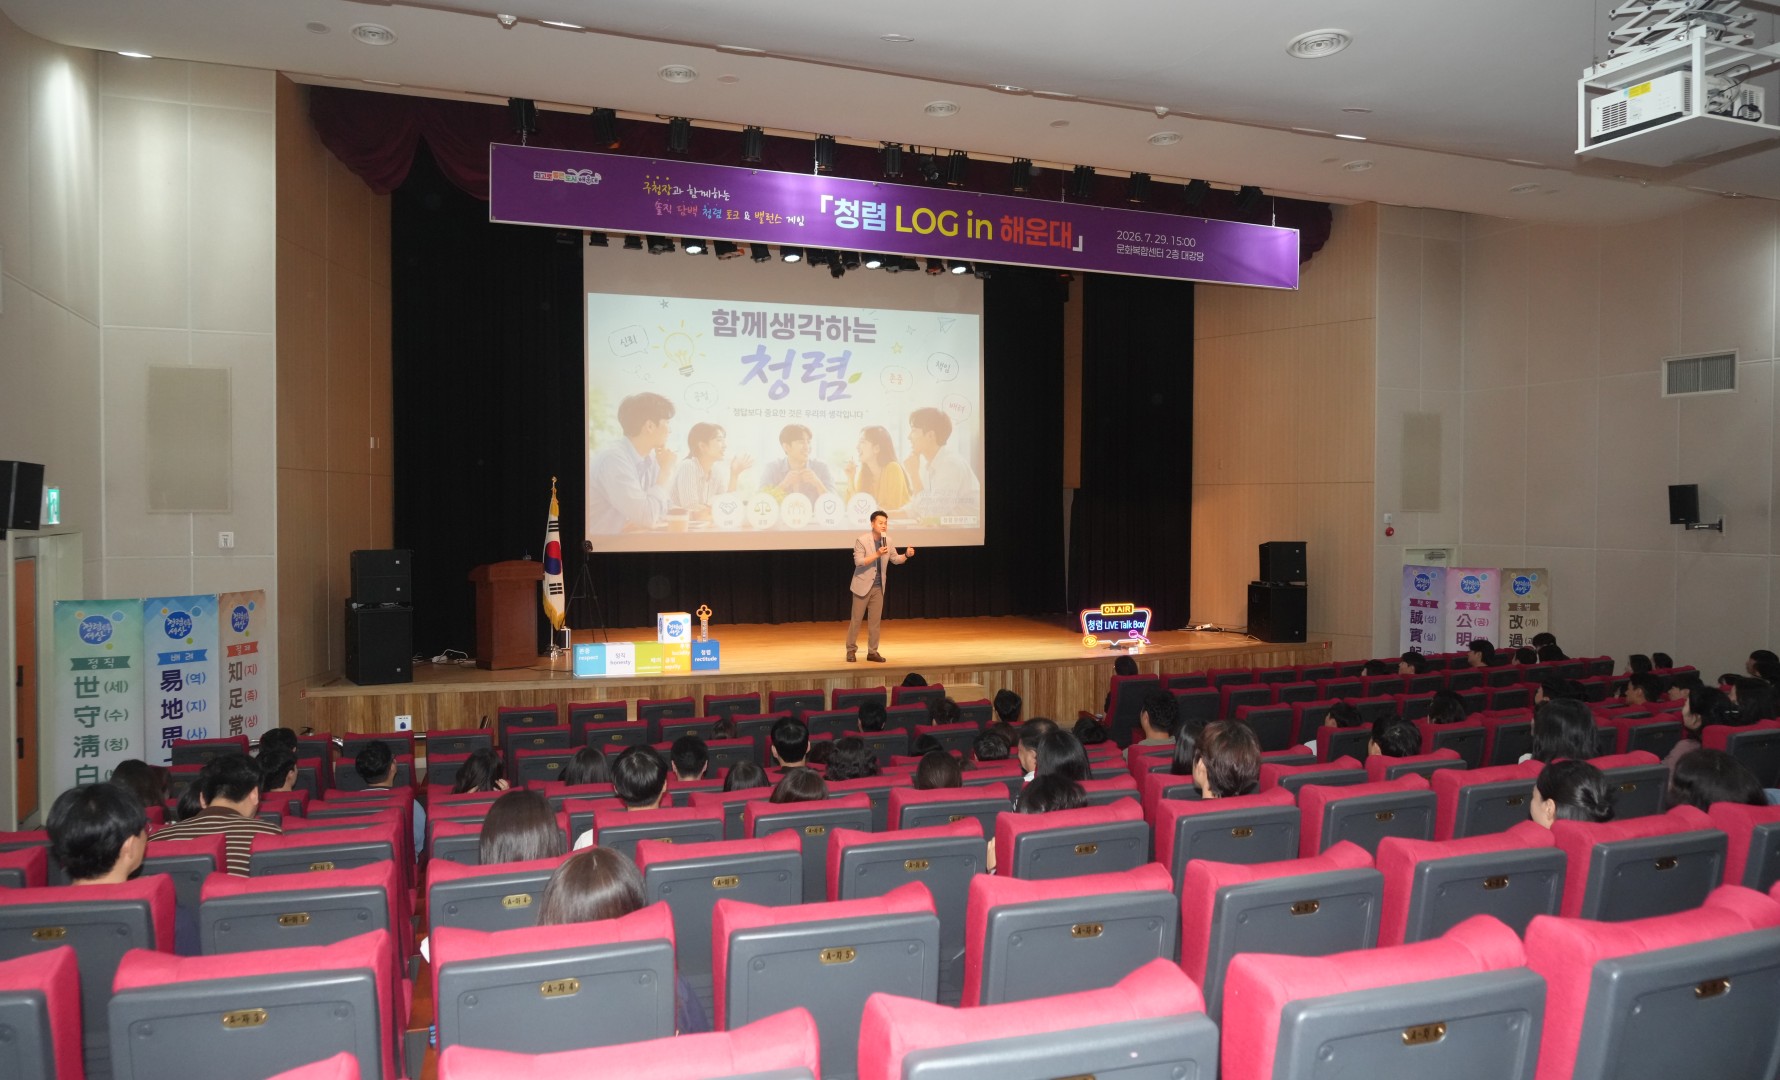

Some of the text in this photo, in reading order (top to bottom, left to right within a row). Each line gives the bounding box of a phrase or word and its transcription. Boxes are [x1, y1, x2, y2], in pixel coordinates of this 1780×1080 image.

[642, 181, 731, 201] 구청장과 함께하는
[654, 201, 805, 226] 솔직 담백 청렴 토크 & 밸런스 게임
[895, 205, 958, 237] LOG
[967, 210, 992, 240] in
[1171, 236, 1196, 247] 15:00
[1116, 244, 1204, 262] 문화복합센터 2층 대강당
[620, 334, 638, 348] 신뢰
[739, 344, 854, 402] 청렴
[936, 360, 952, 374] 책임
[733, 408, 863, 419] 정답보다 중요한 것은 우리의 생각입니다
[1088, 619, 1145, 630] 청렴 LIVE Talk Box
[88, 658, 114, 669] 정직
